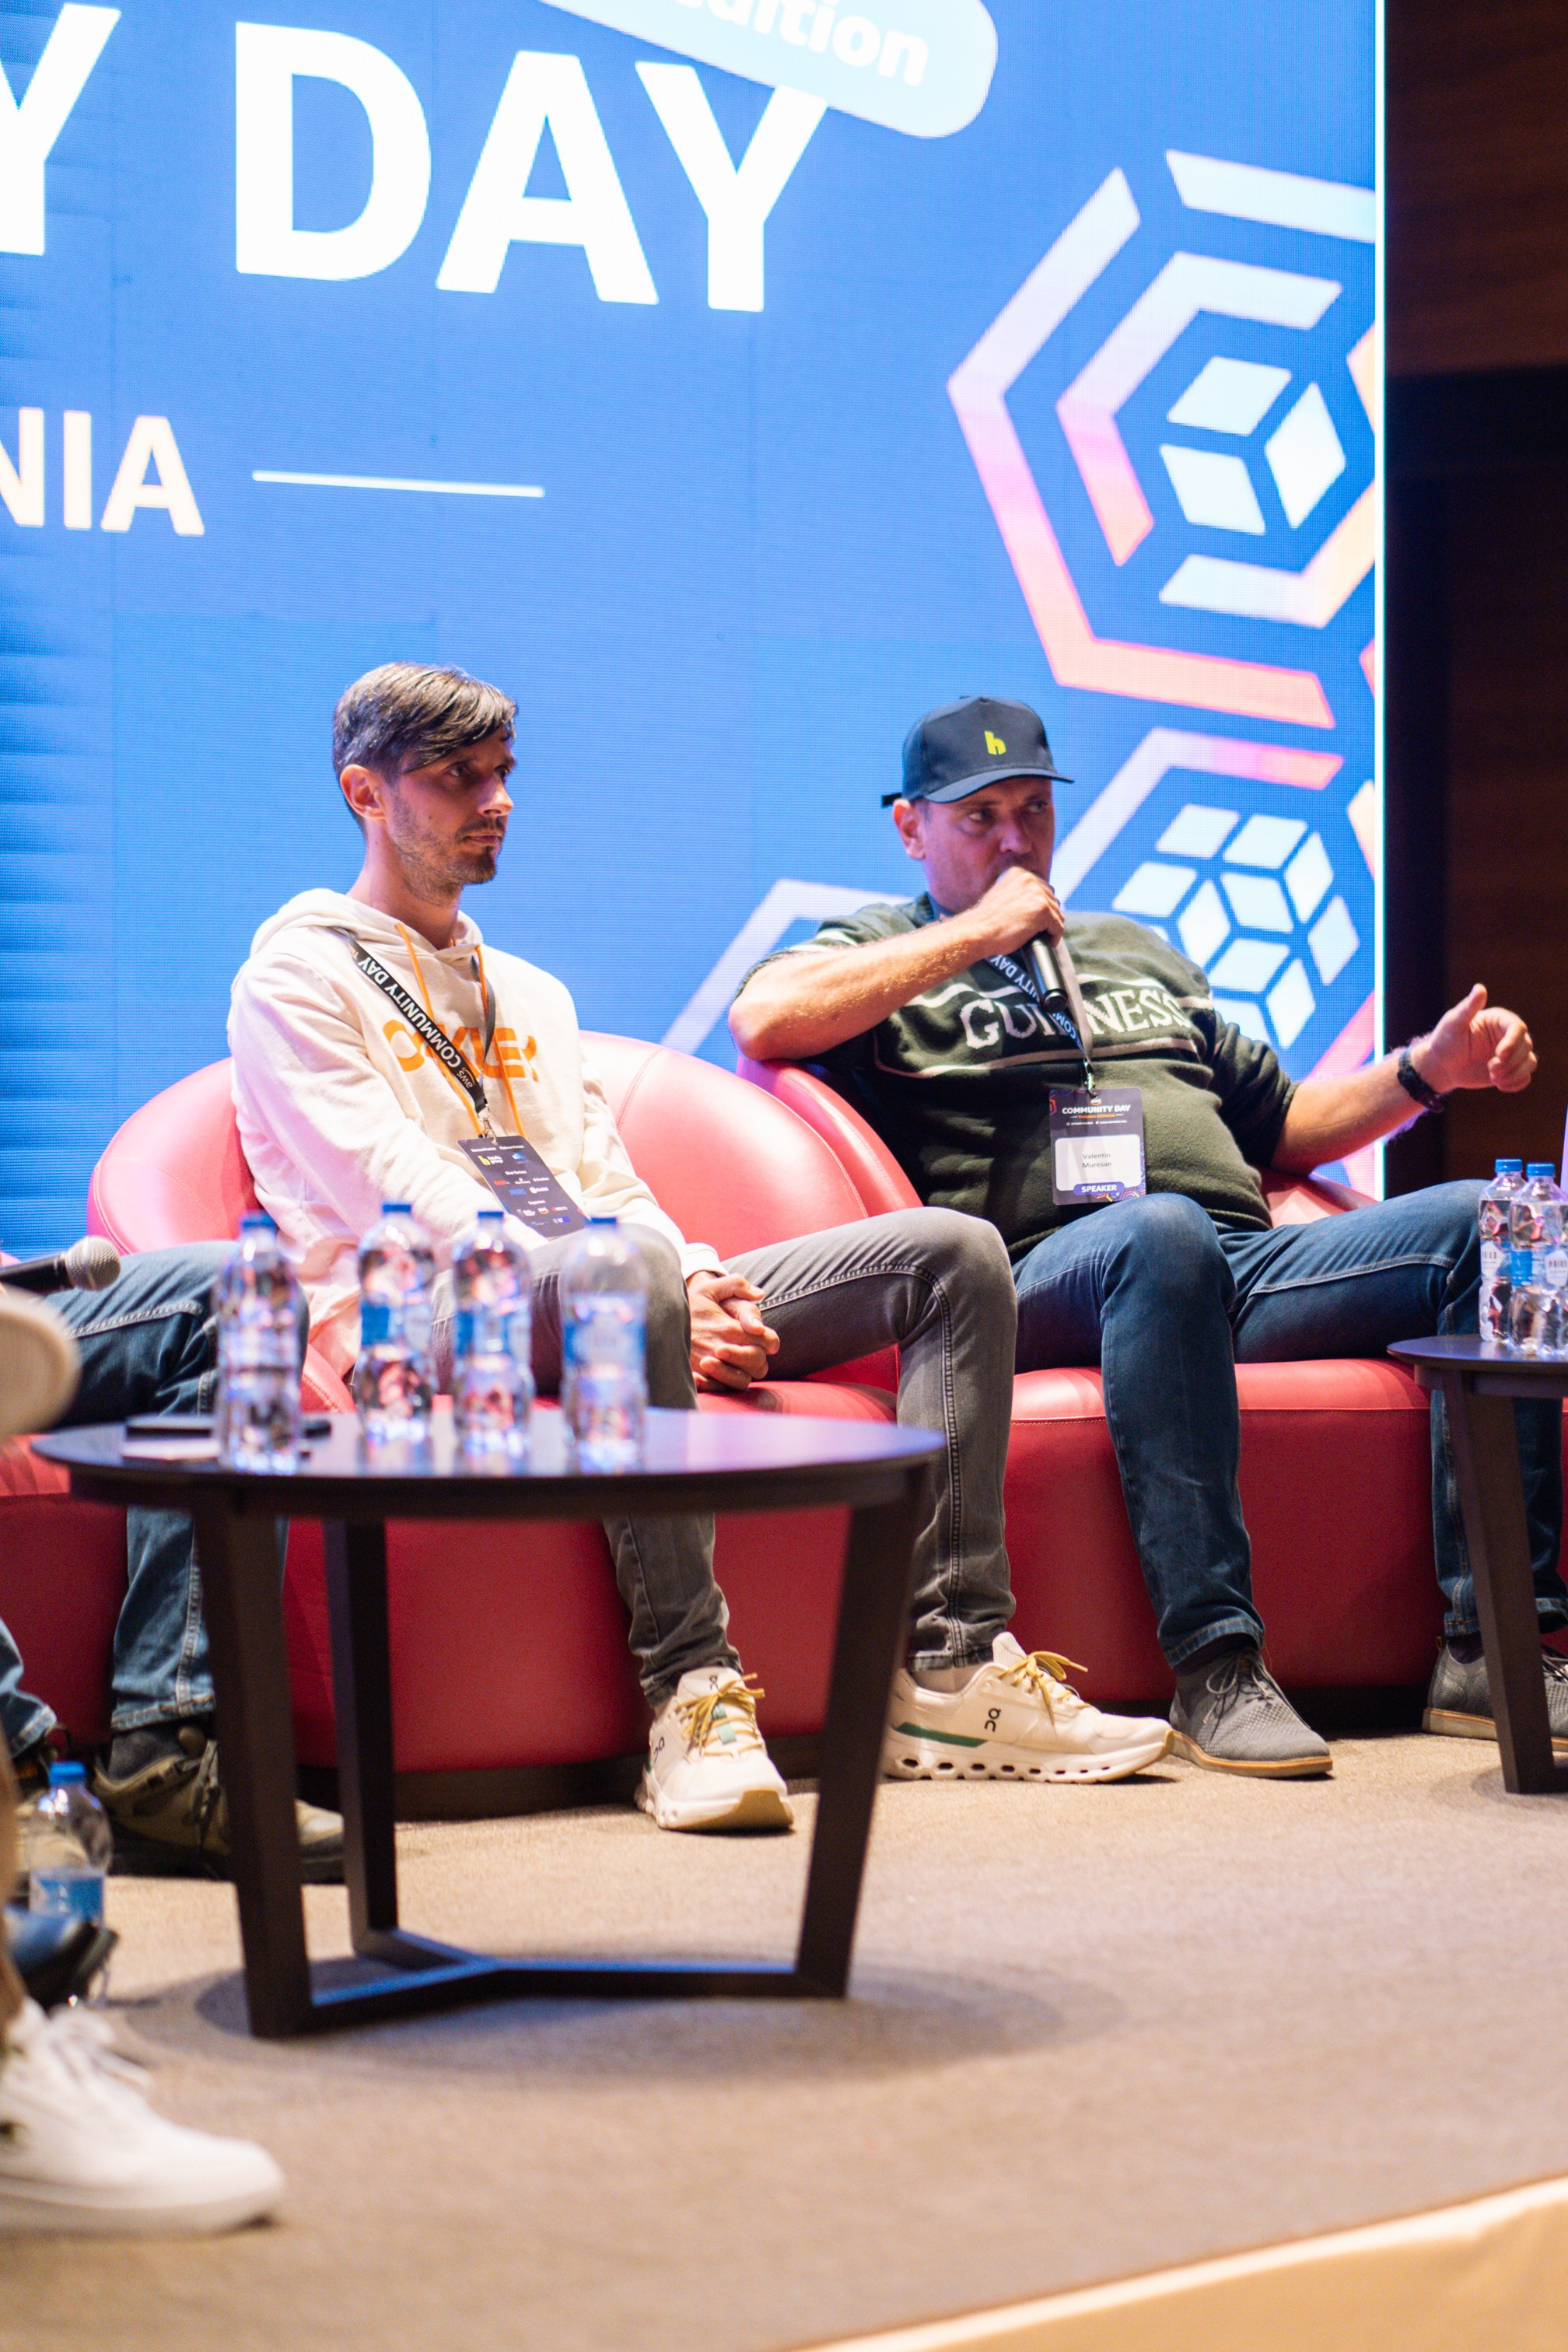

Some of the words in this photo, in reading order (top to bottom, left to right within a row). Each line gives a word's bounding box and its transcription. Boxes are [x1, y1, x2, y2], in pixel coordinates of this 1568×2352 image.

[675, 0, 929, 87] ition
[235, 21, 829, 313] DAY
[358, 957, 390, 985] DAY
[990, 955, 1019, 978] DAY
[384, 984, 461, 1068] COMMUNITY
[1062, 1105, 1113, 1115] COMMUNITY
[1114, 1104, 1132, 1112] DAY
[1081, 1185, 1117, 1193] SPEAKER
